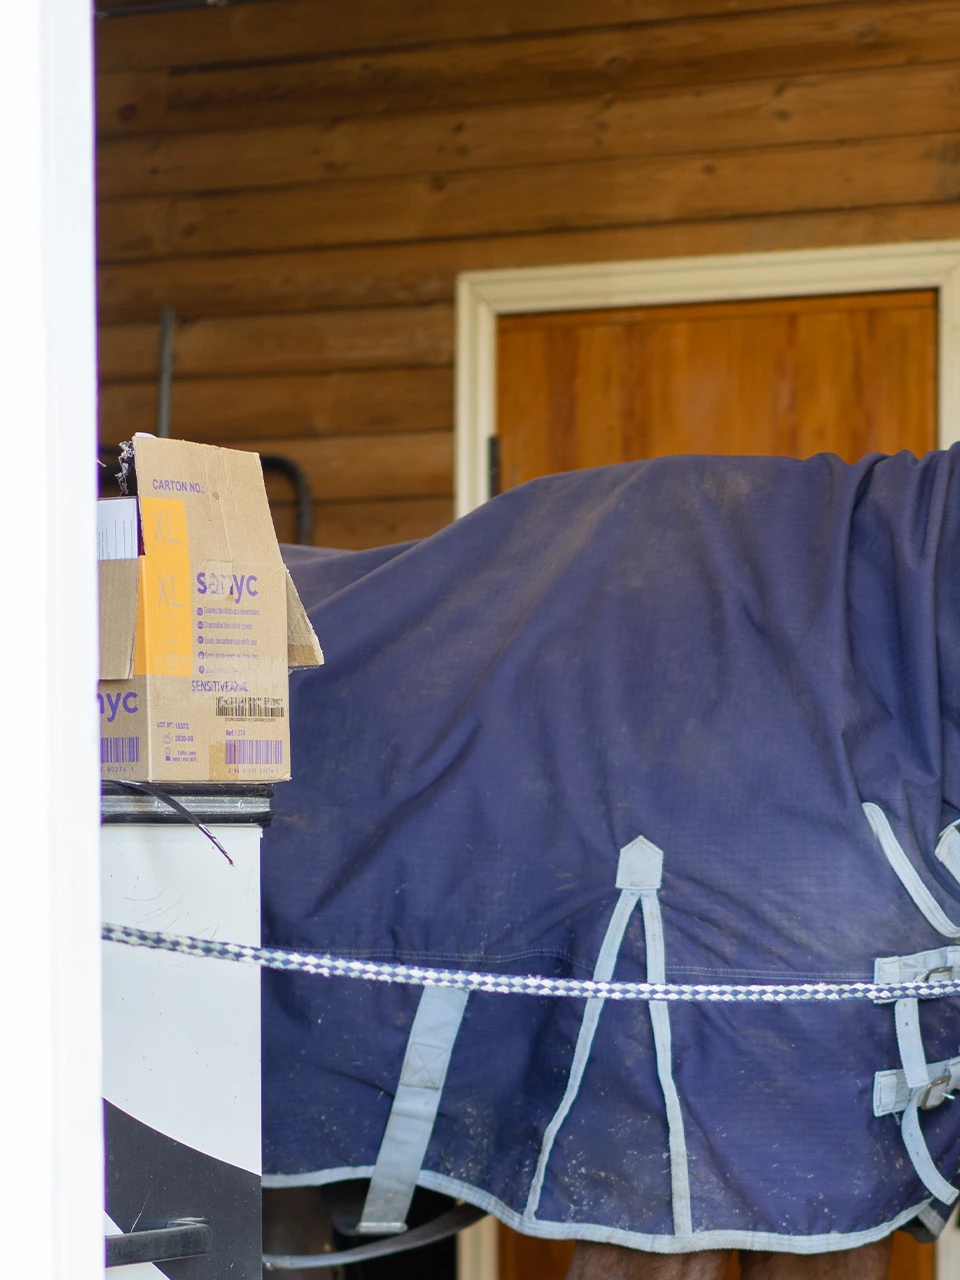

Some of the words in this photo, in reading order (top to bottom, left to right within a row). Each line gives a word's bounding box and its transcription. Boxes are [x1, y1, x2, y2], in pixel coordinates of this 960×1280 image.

[152, 479, 188, 492] CARTON
[152, 509, 180, 545] XL
[157, 573, 183, 608] XL
